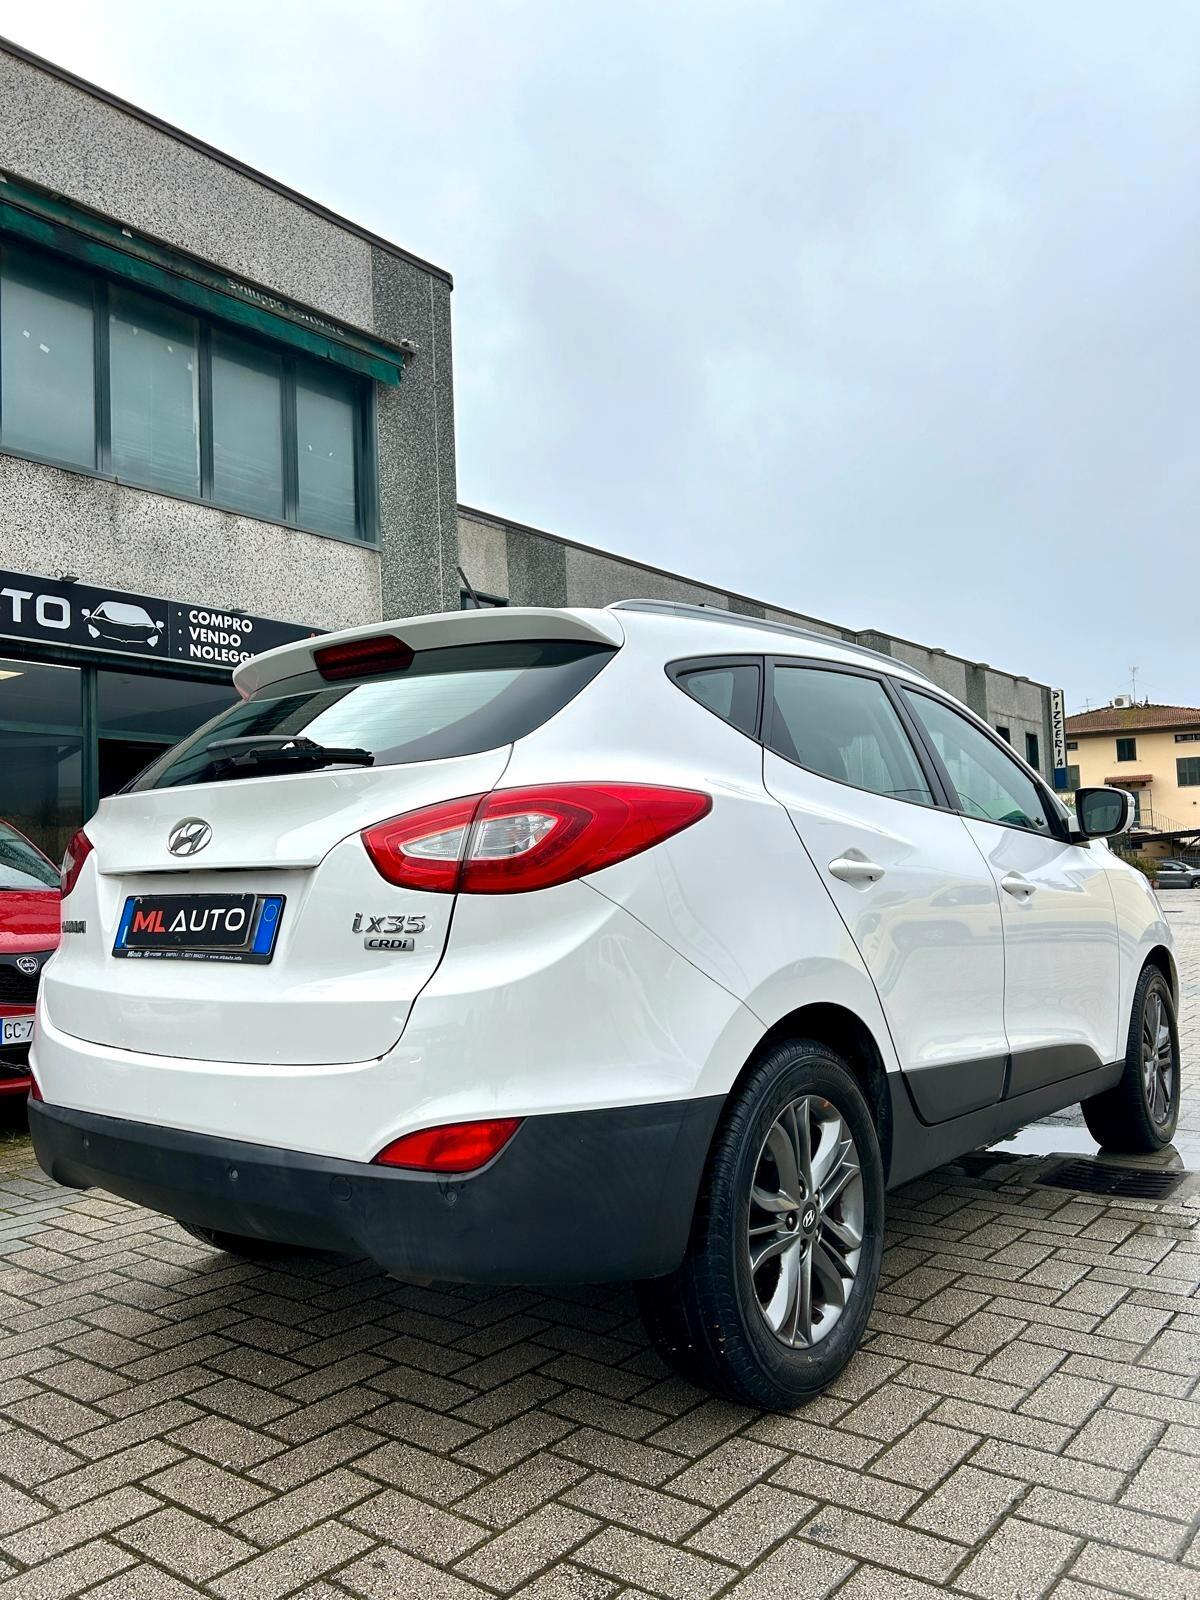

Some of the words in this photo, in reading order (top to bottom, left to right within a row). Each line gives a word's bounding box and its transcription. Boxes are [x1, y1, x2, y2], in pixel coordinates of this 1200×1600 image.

[0, 587, 71, 630] TO
[188, 610, 253, 633] COMPRO
[189, 626, 242, 647] VENDO
[1052, 692, 1064, 768] PIZZERIA
[132, 910, 166, 933] ML
[168, 908, 246, 932] AUTO
[351, 912, 426, 934] ix35
[368, 939, 408, 949] CRDi
[4, 1022, 21, 1040] GC
